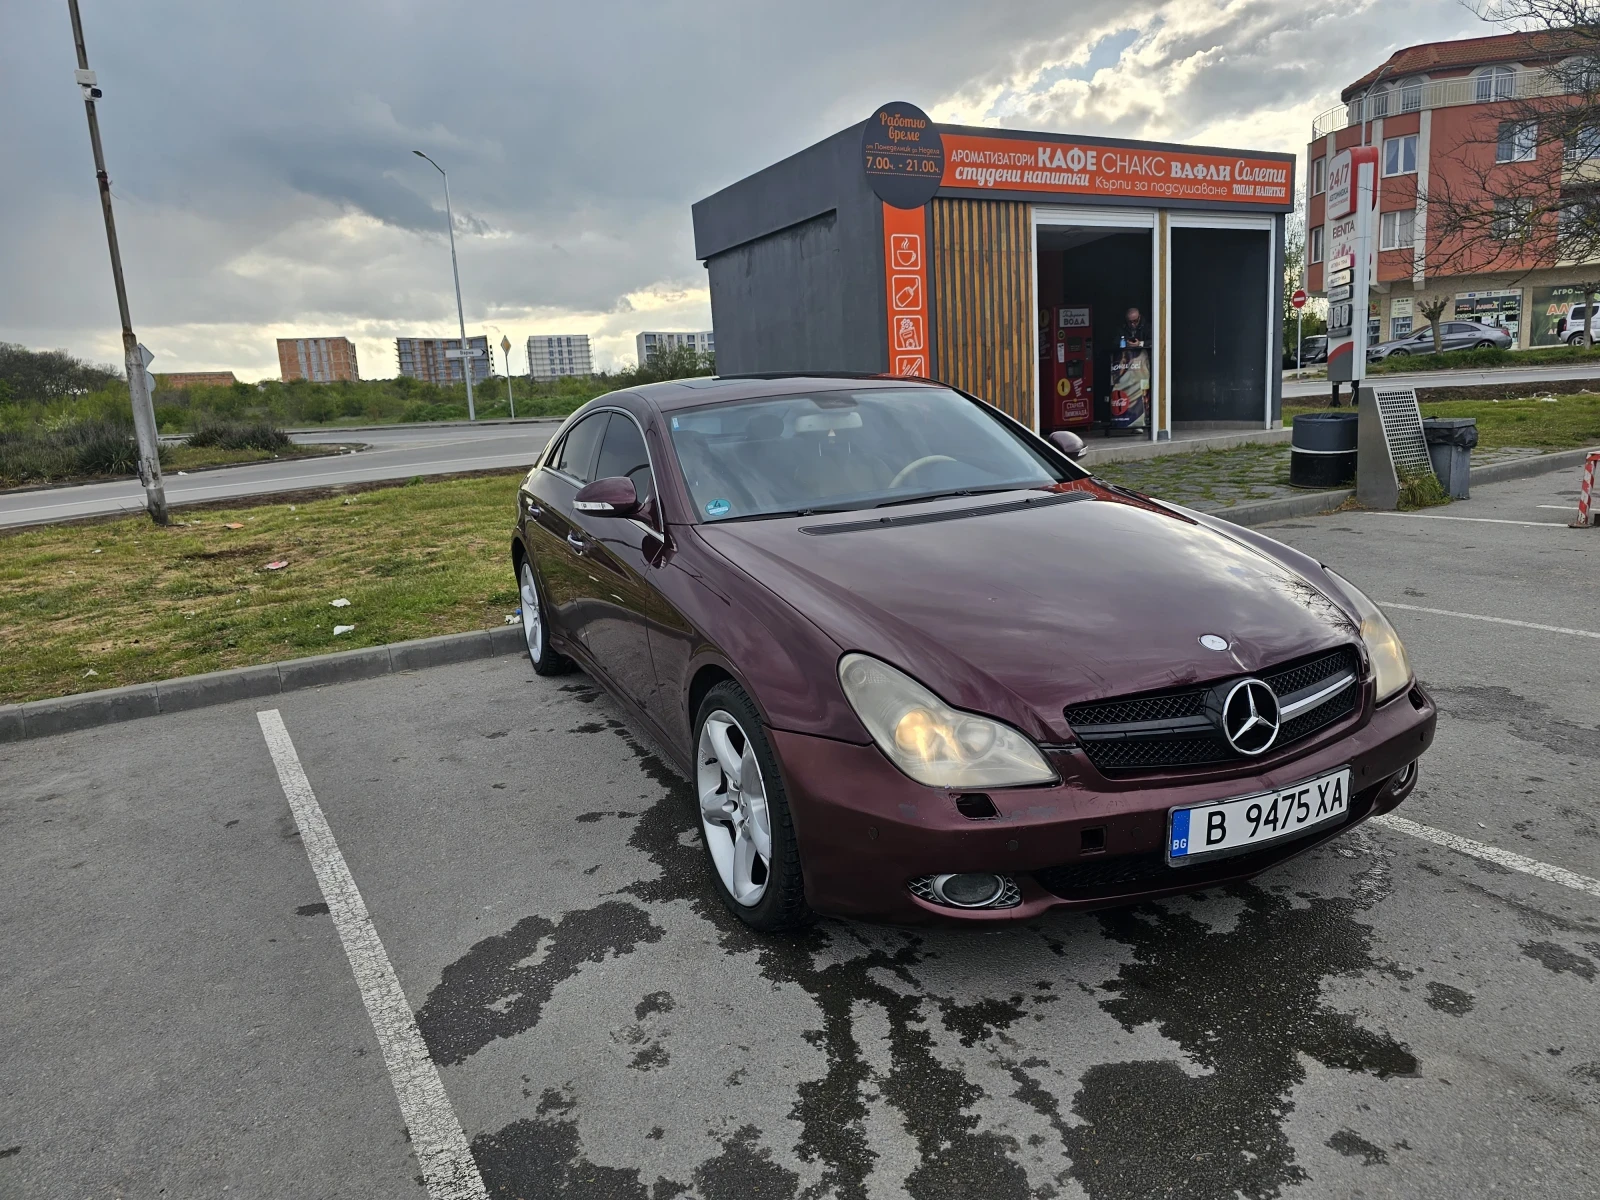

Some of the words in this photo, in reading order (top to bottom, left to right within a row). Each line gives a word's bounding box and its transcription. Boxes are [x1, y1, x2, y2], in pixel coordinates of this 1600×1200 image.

[880, 112, 926, 129] Работно
[888, 126, 920, 143] време
[874, 142, 911, 154] Понеделник
[918, 147, 940, 156] Неделя
[866, 156, 896, 170] 7.00ч.
[906, 159, 941, 173] 21.00ч.
[951, 149, 1035, 167] АРОМАТИЗАТОРИ
[1037, 147, 1097, 172] КАФЕ
[1101, 152, 1166, 177] СНАКС
[1170, 161, 1231, 181] ВАФЛИ
[1234, 160, 1287, 184] Солети
[955, 166, 1021, 187] студени
[1023, 171, 1090, 187] напитки
[1095, 176, 1131, 192] Кърпи
[1134, 181, 1148, 191] за
[1150, 182, 1228, 196] подсушаване
[1232, 183, 1255, 196] ТОПЛИ
[1255, 186, 1286, 198] НАПИТКИ
[1329, 162, 1350, 191] 24/7
[1552, 288, 1574, 296] АГРО
[1063, 318, 1086, 326] ВОДА
[1060, 381, 1065, 392] 1
[1206, 810, 1227, 846] B
[1245, 788, 1311, 838] 9475
[1315, 777, 1343, 818] XA
[1172, 838, 1187, 851] BG
